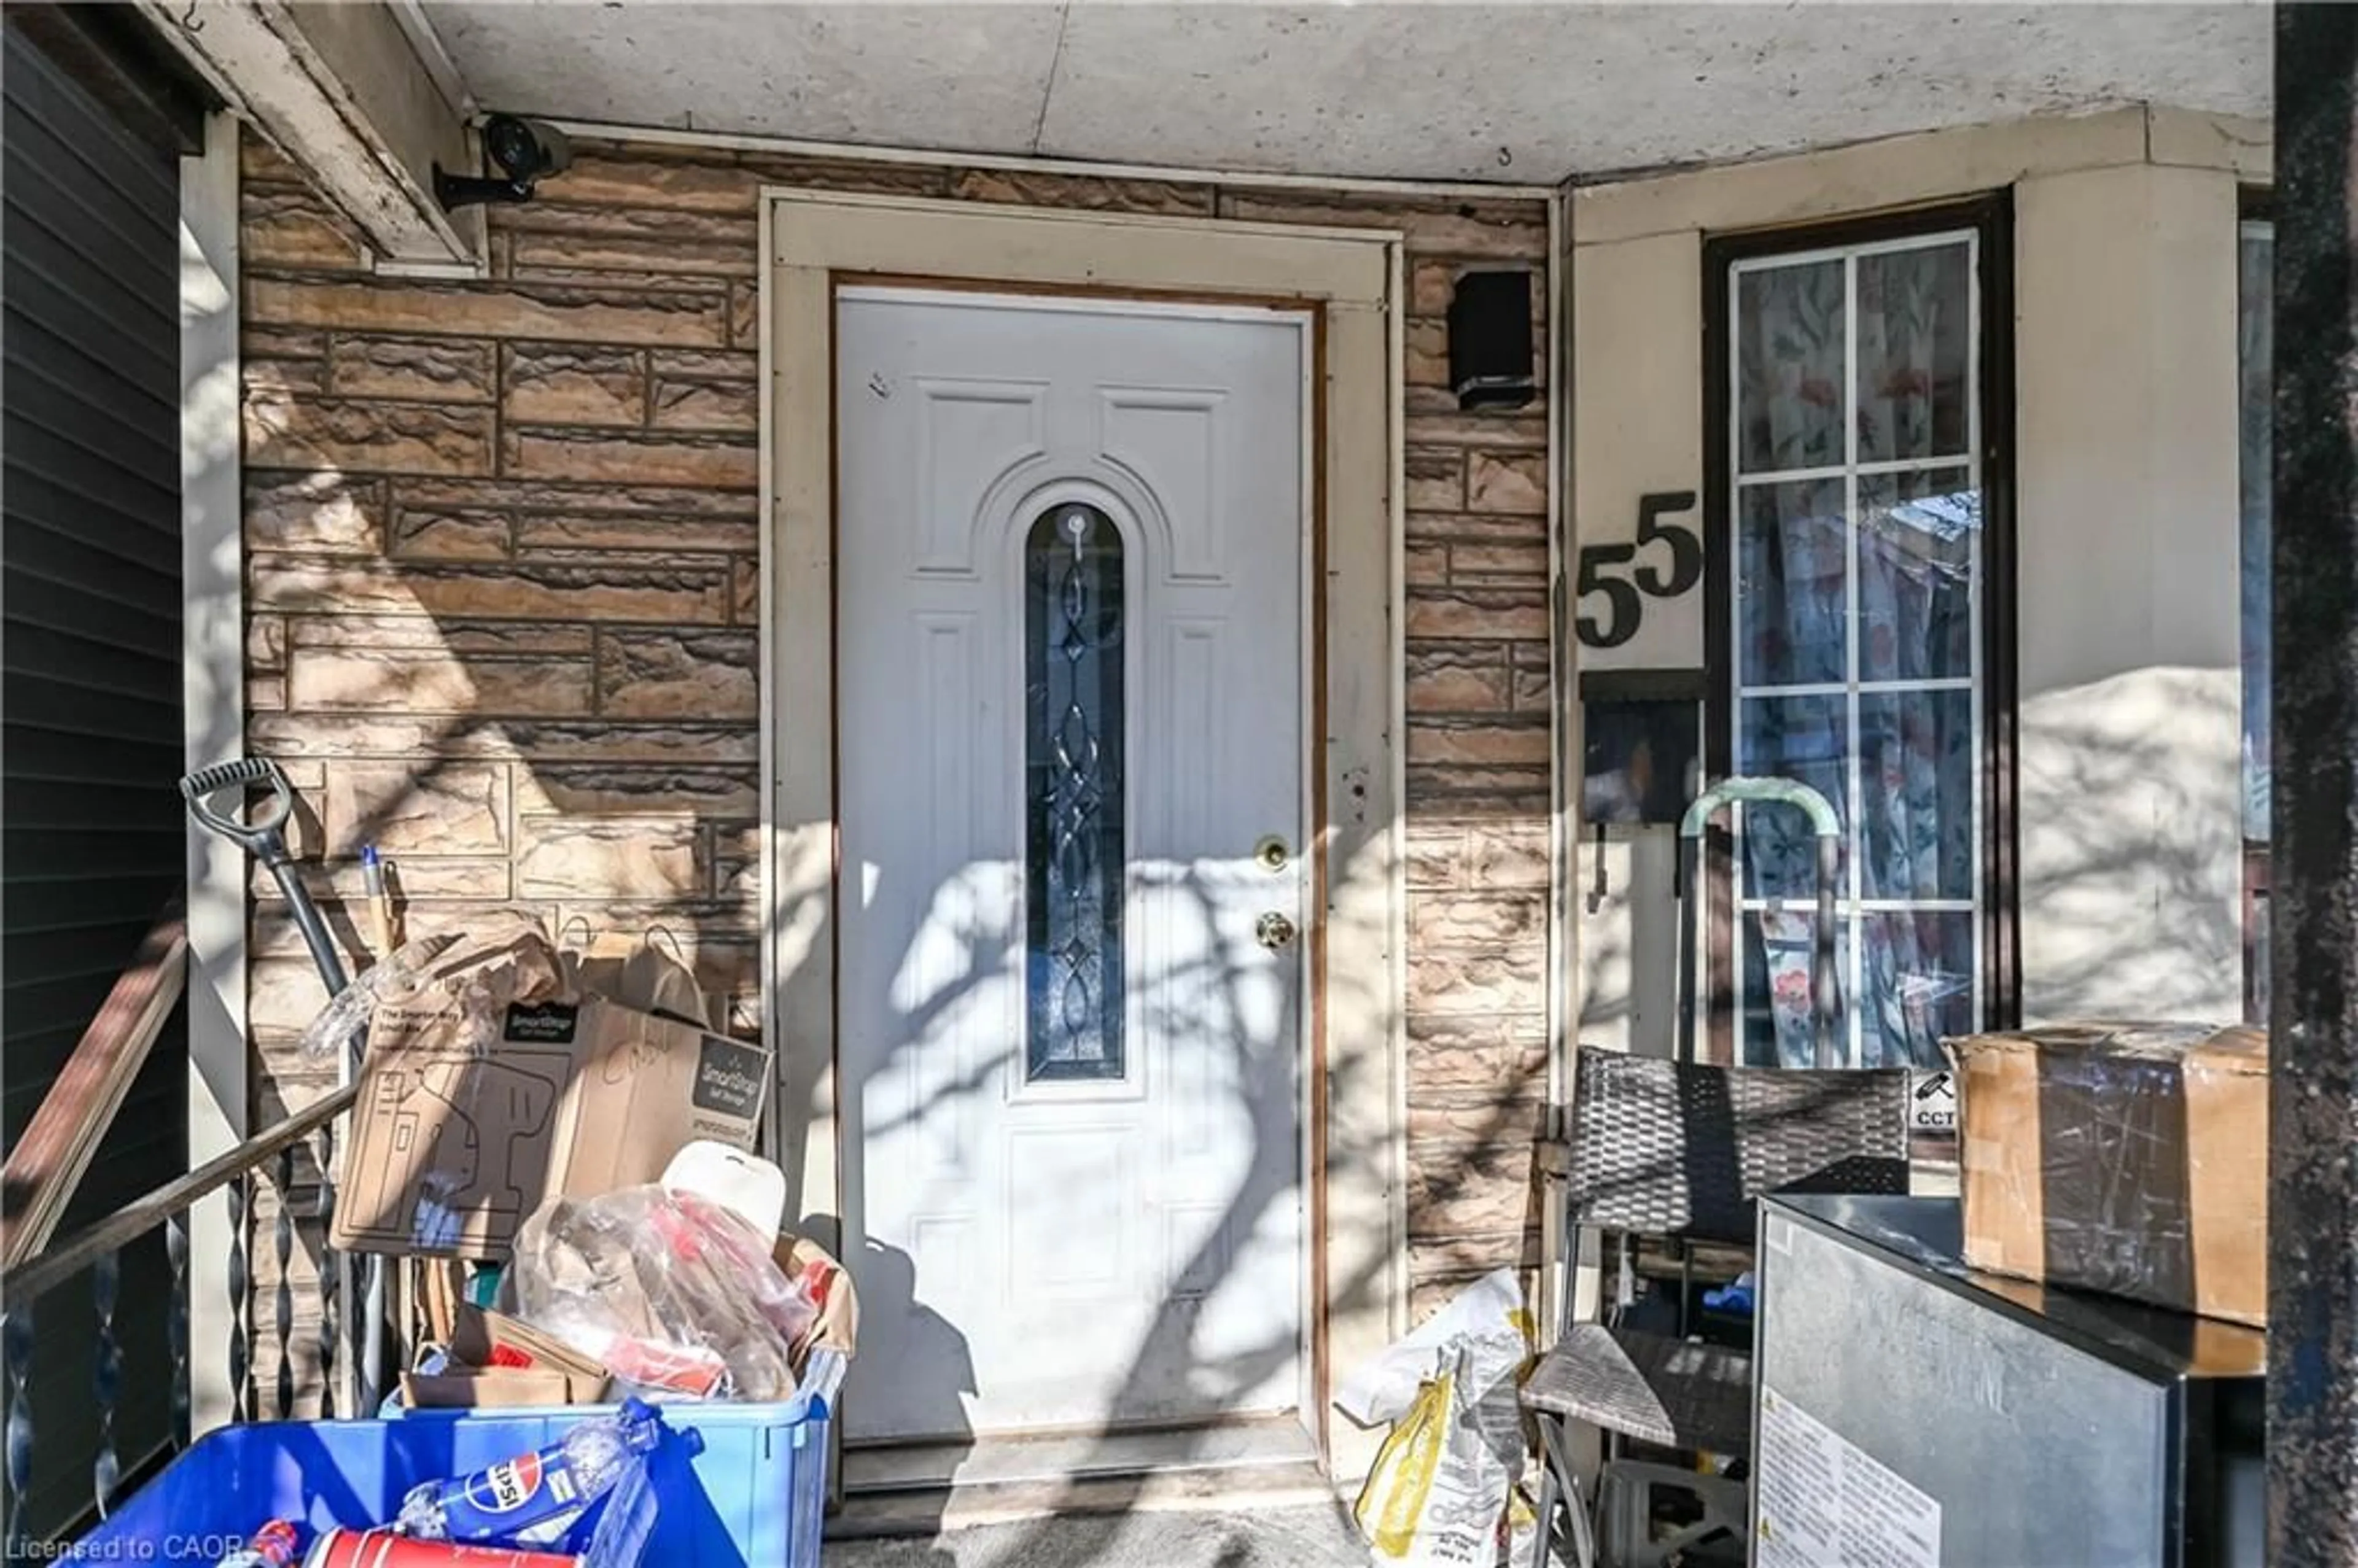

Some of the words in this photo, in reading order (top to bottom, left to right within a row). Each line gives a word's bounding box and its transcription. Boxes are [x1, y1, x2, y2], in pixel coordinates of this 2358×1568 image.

[1575, 491, 1701, 648] 55
[1917, 1111, 1954, 1125] CCT
[495, 1461, 519, 1507] EPSI
